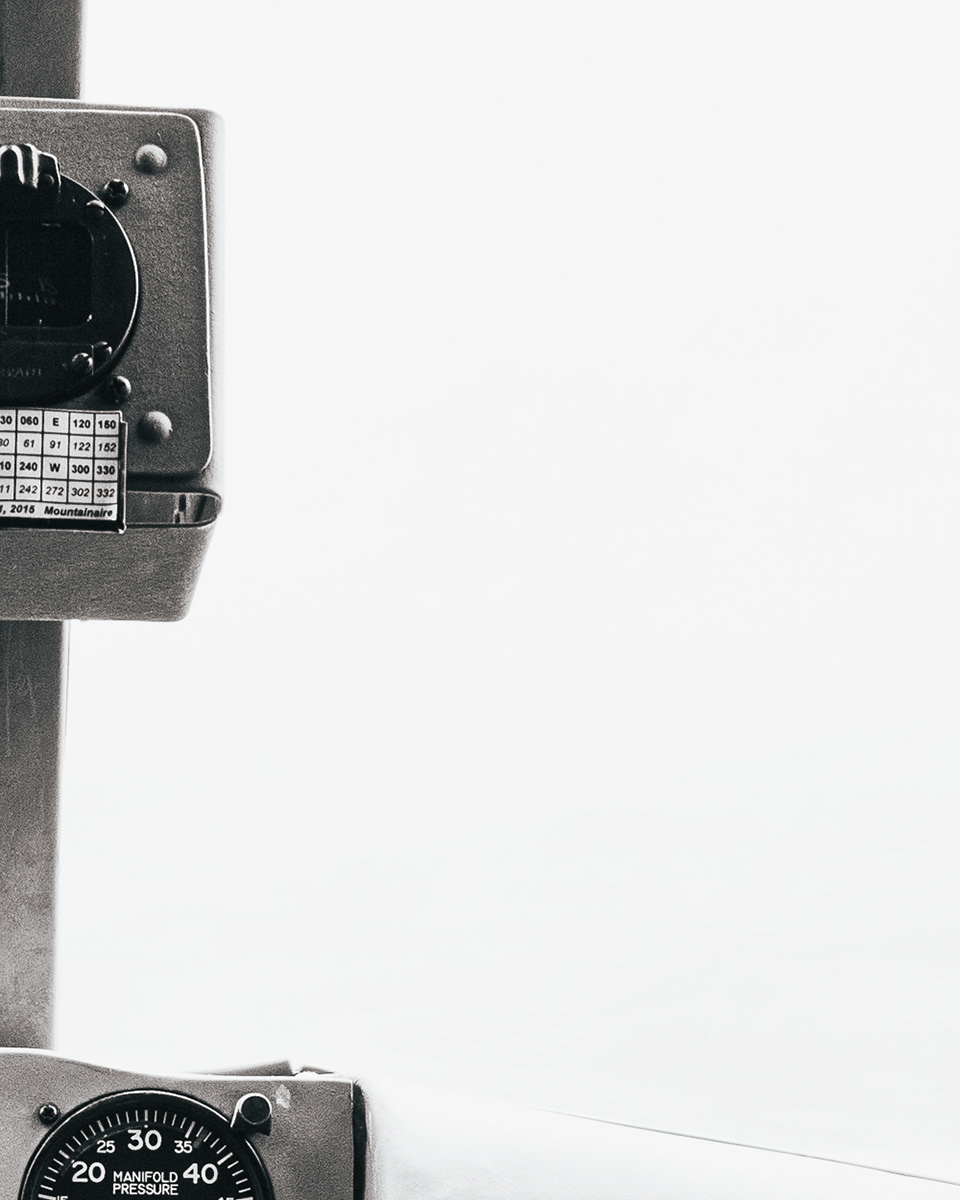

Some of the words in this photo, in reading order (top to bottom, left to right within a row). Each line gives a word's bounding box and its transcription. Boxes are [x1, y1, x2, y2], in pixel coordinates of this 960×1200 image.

[20, 416, 39, 426] 060
[53, 418, 59, 426] E
[73, 419, 91, 429] 120
[23, 439, 35, 448] 61
[49, 440, 61, 449] 91
[73, 442, 91, 451] 122
[98, 442, 117, 452] 152
[19, 461, 38, 471] 240
[49, 463, 61, 472] W
[71, 464, 90, 474] 300
[96, 465, 115, 475] 330
[19, 485, 37, 494] 242
[45, 486, 64, 496] 272
[71, 487, 89, 497] 302
[96, 488, 115, 498] 332
[10, 505, 35, 514] 2015
[44, 506, 113, 518] Mountainaire
[96, 1140, 116, 1154] 25
[127, 1130, 162, 1151] 30
[174, 1140, 193, 1154] 35
[72, 1162, 105, 1183] 20
[113, 1171, 178, 1184] MANIFOLD
[182, 1163, 218, 1184] 40
[112, 1184, 179, 1195] PRESSURE
